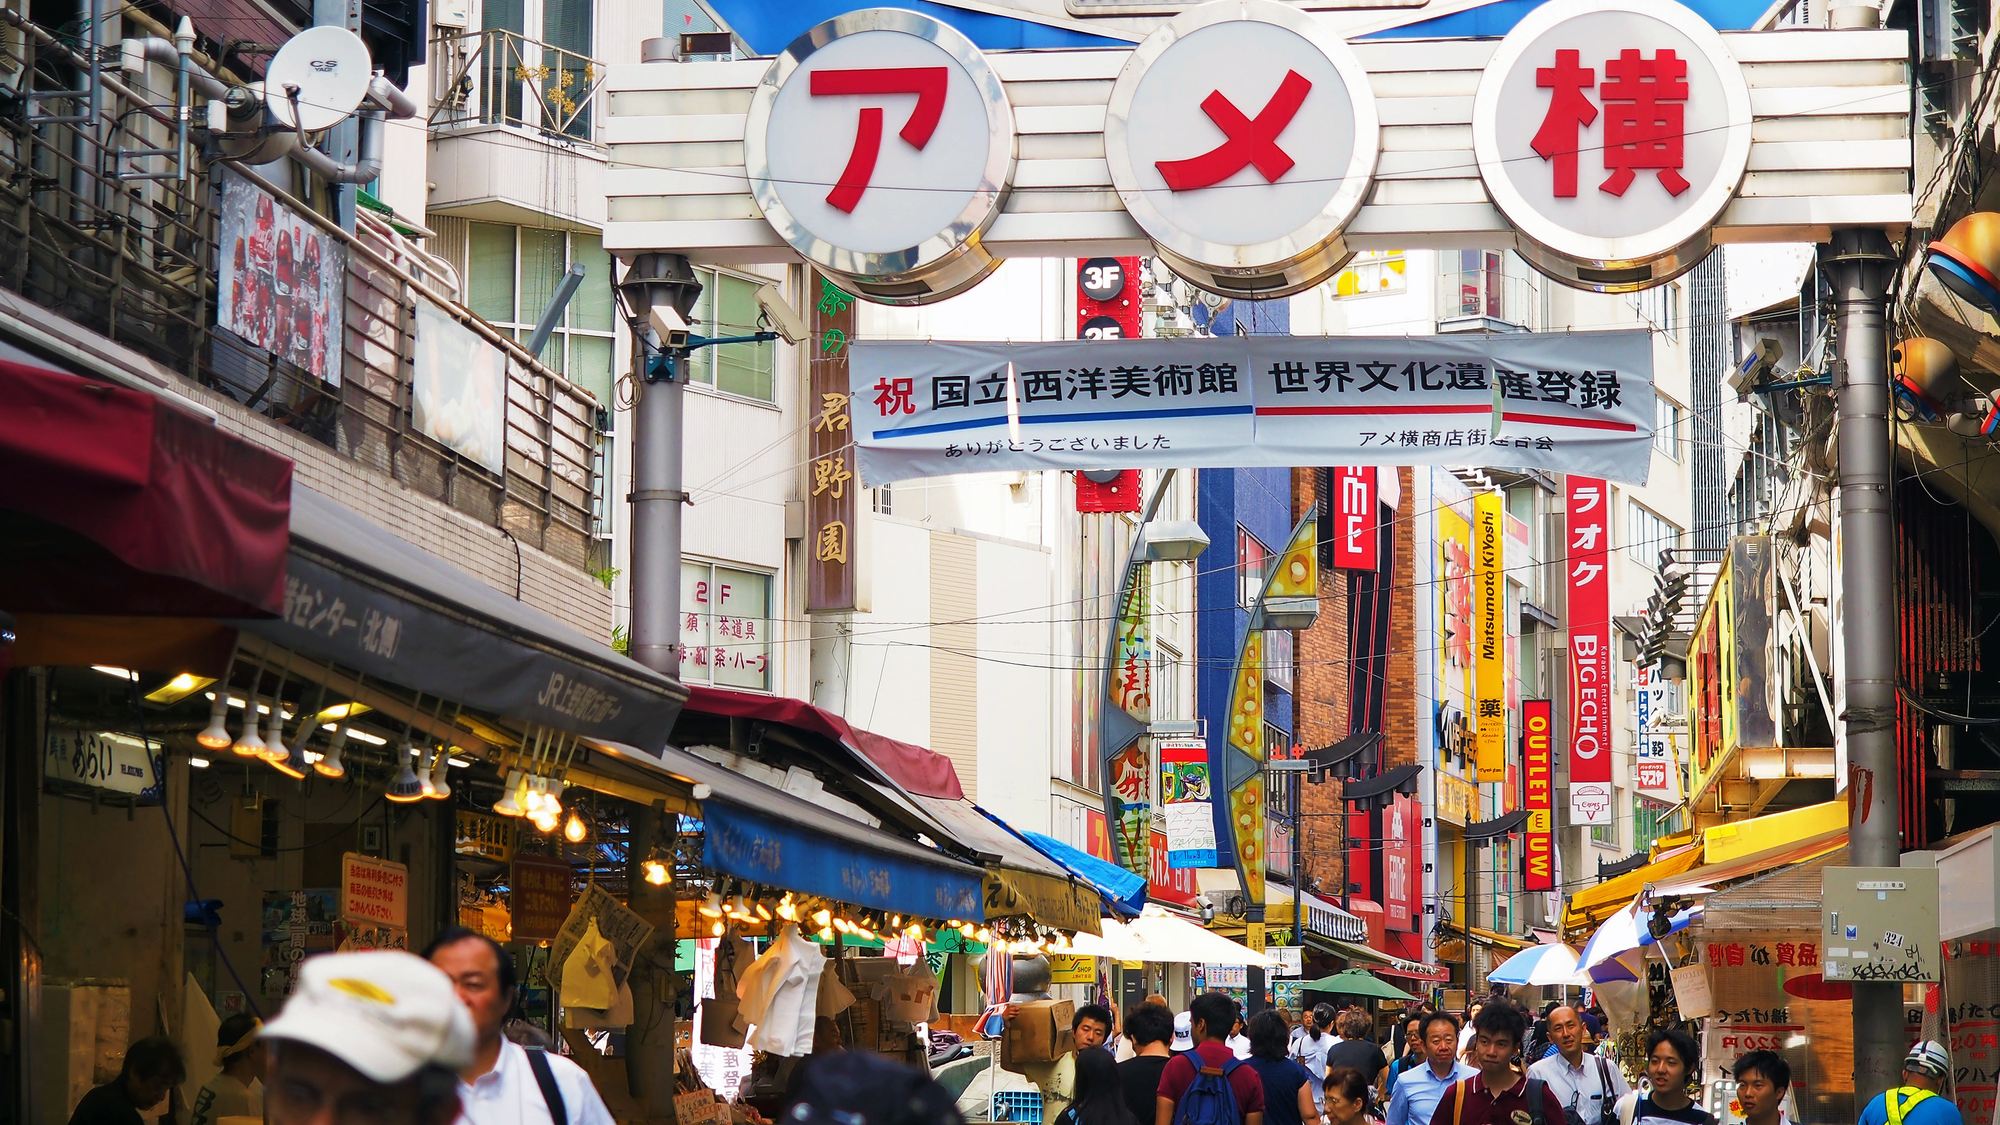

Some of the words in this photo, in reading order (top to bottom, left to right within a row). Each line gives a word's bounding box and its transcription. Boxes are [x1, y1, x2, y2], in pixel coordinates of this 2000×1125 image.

[810, 48, 1690, 213] アメ横
[1084, 266, 1120, 290] 3F
[873, 375, 916, 416] 祝
[931, 362, 1238, 411] 国立西洋美術館
[1267, 360, 1621, 410] 世界文化遺産登録
[944, 433, 1171, 459] ありがとうございました
[1571, 486, 1603, 588] ラオケ
[696, 581, 731, 605] 2F
[1482, 570, 1495, 660] Matsumoto
[680, 613, 756, 640] 須・茶道具
[1573, 635, 1598, 683] BIG
[1600, 645, 1608, 680] Karaoke
[1480, 698, 1501, 718] 薬
[1575, 687, 1599, 760] ECHO
[1601, 683, 1609, 746] Entertainment
[1528, 716, 1548, 804] OUTLET
[1640, 770, 1665, 786] マスヤ
[1530, 837, 1548, 877] UW
